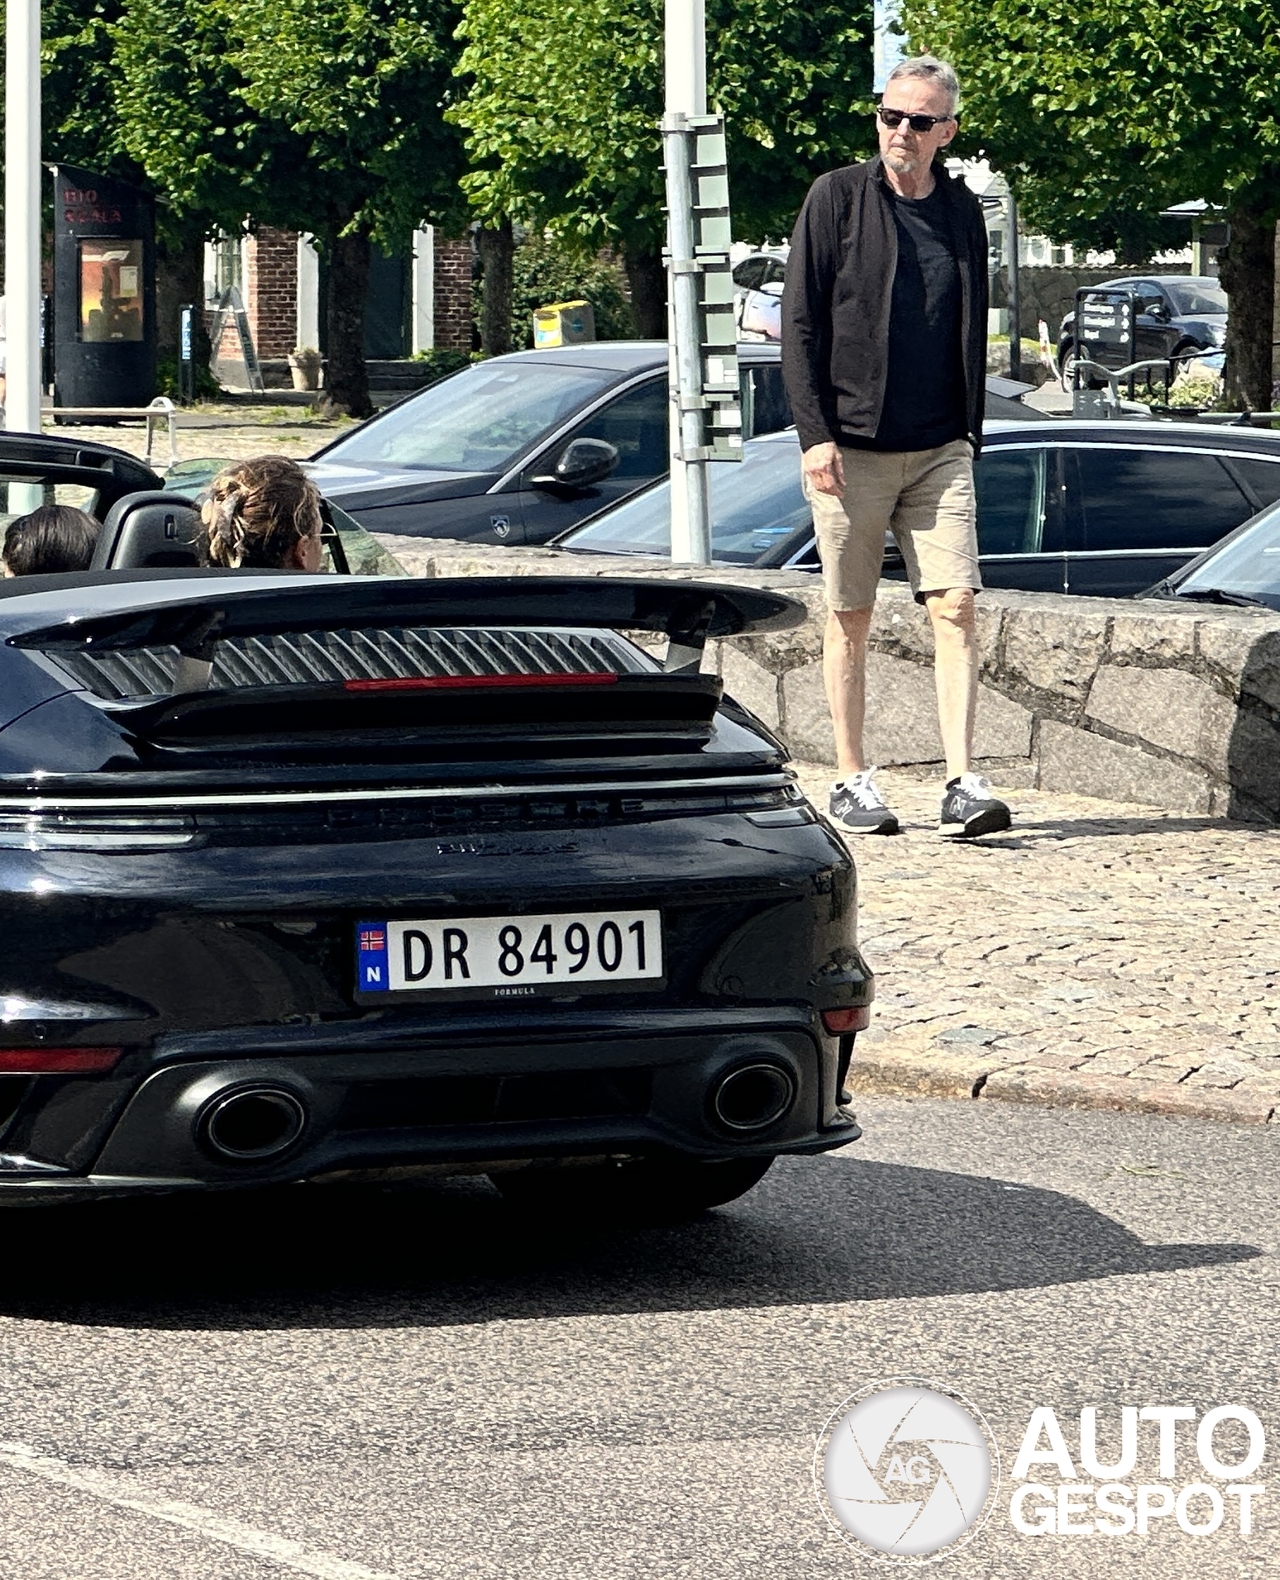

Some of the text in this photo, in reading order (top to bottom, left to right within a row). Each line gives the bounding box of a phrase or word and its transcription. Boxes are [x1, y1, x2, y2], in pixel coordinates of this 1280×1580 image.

[403, 920, 646, 982] DR 84901
[366, 966, 381, 982] N
[494, 987, 535, 997] FORMULA
